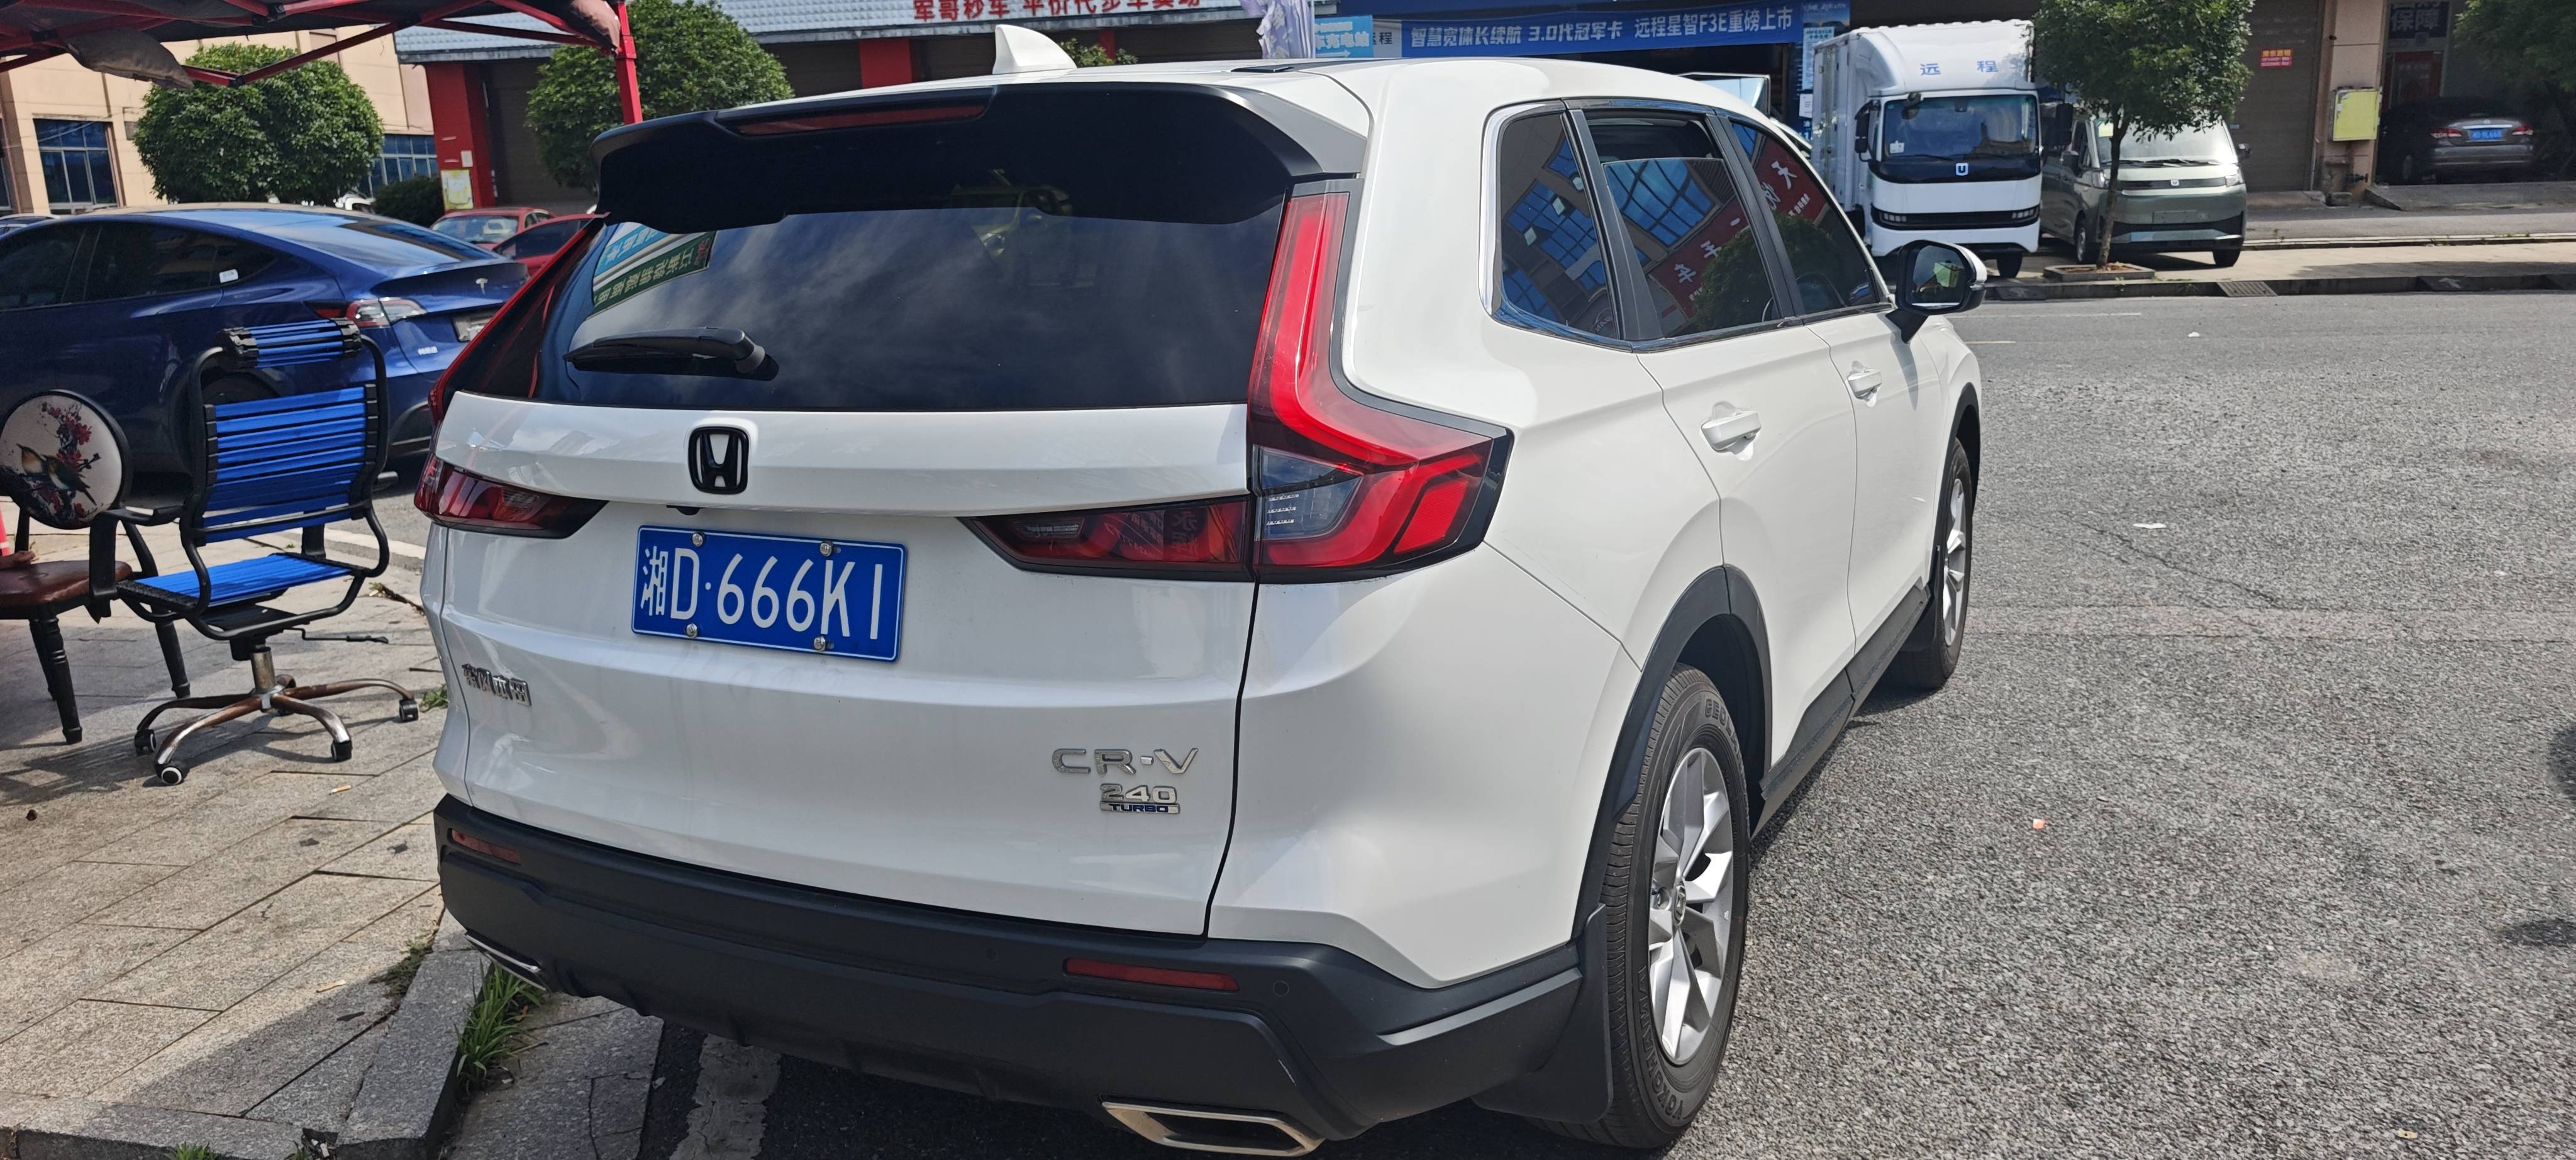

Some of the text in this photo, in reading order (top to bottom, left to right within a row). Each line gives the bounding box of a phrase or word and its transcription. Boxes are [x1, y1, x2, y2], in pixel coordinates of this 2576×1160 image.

[1023, 0, 1200, 16] 平价代步
[1411, 25, 1522, 47] 智慧宽体长续航
[1528, 21, 1623, 42] 3.0代冠军卡
[1635, 6, 1793, 39] 远程星智F3E重磅上市
[1052, 747, 1199, 775] CR-V
[1100, 783, 1177, 803] 240
[1109, 803, 1169, 813] TURBO
